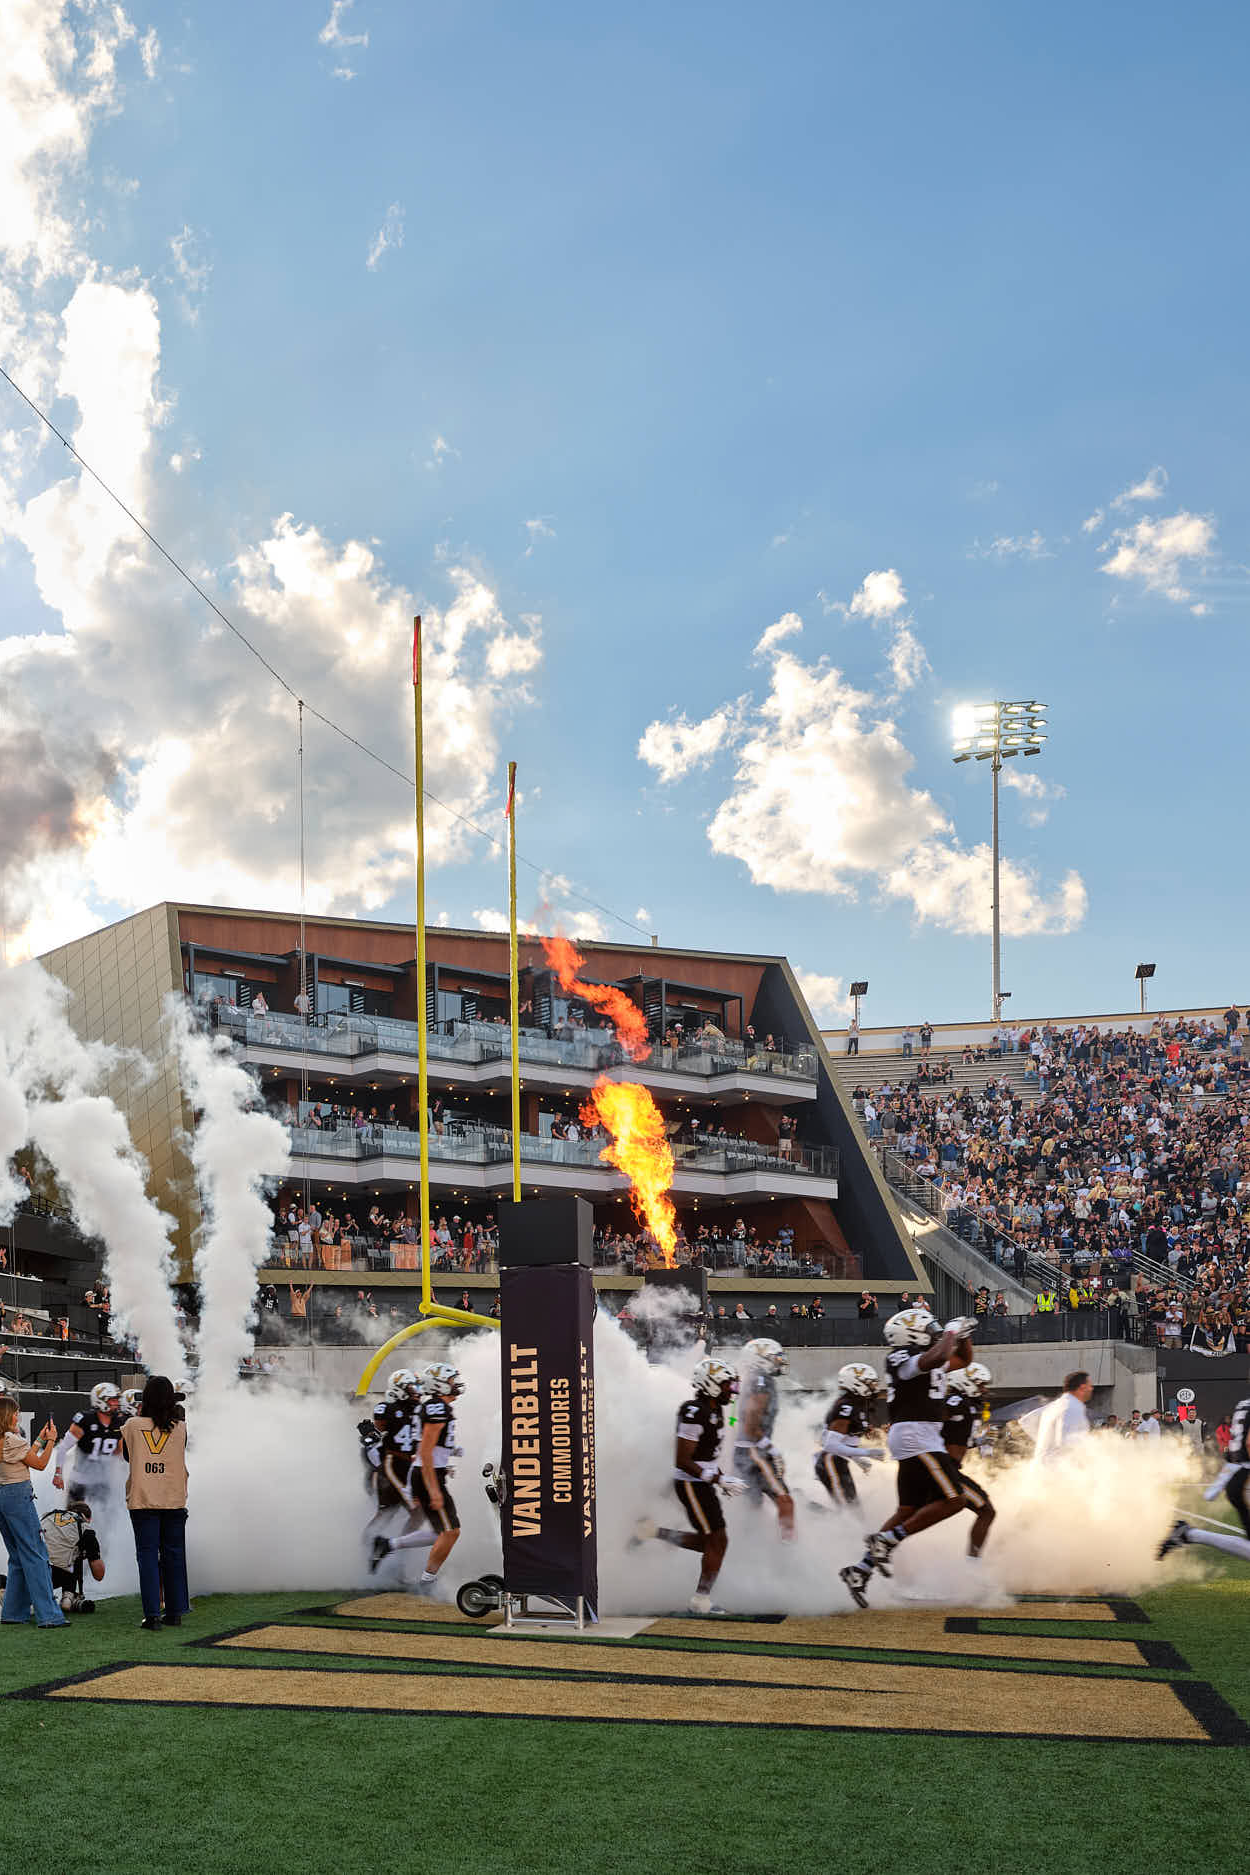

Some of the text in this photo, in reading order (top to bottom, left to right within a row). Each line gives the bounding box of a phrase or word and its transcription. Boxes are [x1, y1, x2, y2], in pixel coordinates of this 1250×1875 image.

[1107, 1278, 1113, 1287] G
[838, 1404, 853, 1417] 3
[89, 1437, 118, 1462] 19
[140, 1429, 171, 1455] V
[510, 1343, 542, 1538] VANDERBILT
[550, 1377, 573, 1503] COMMODORES
[144, 1462, 165, 1474] 063
